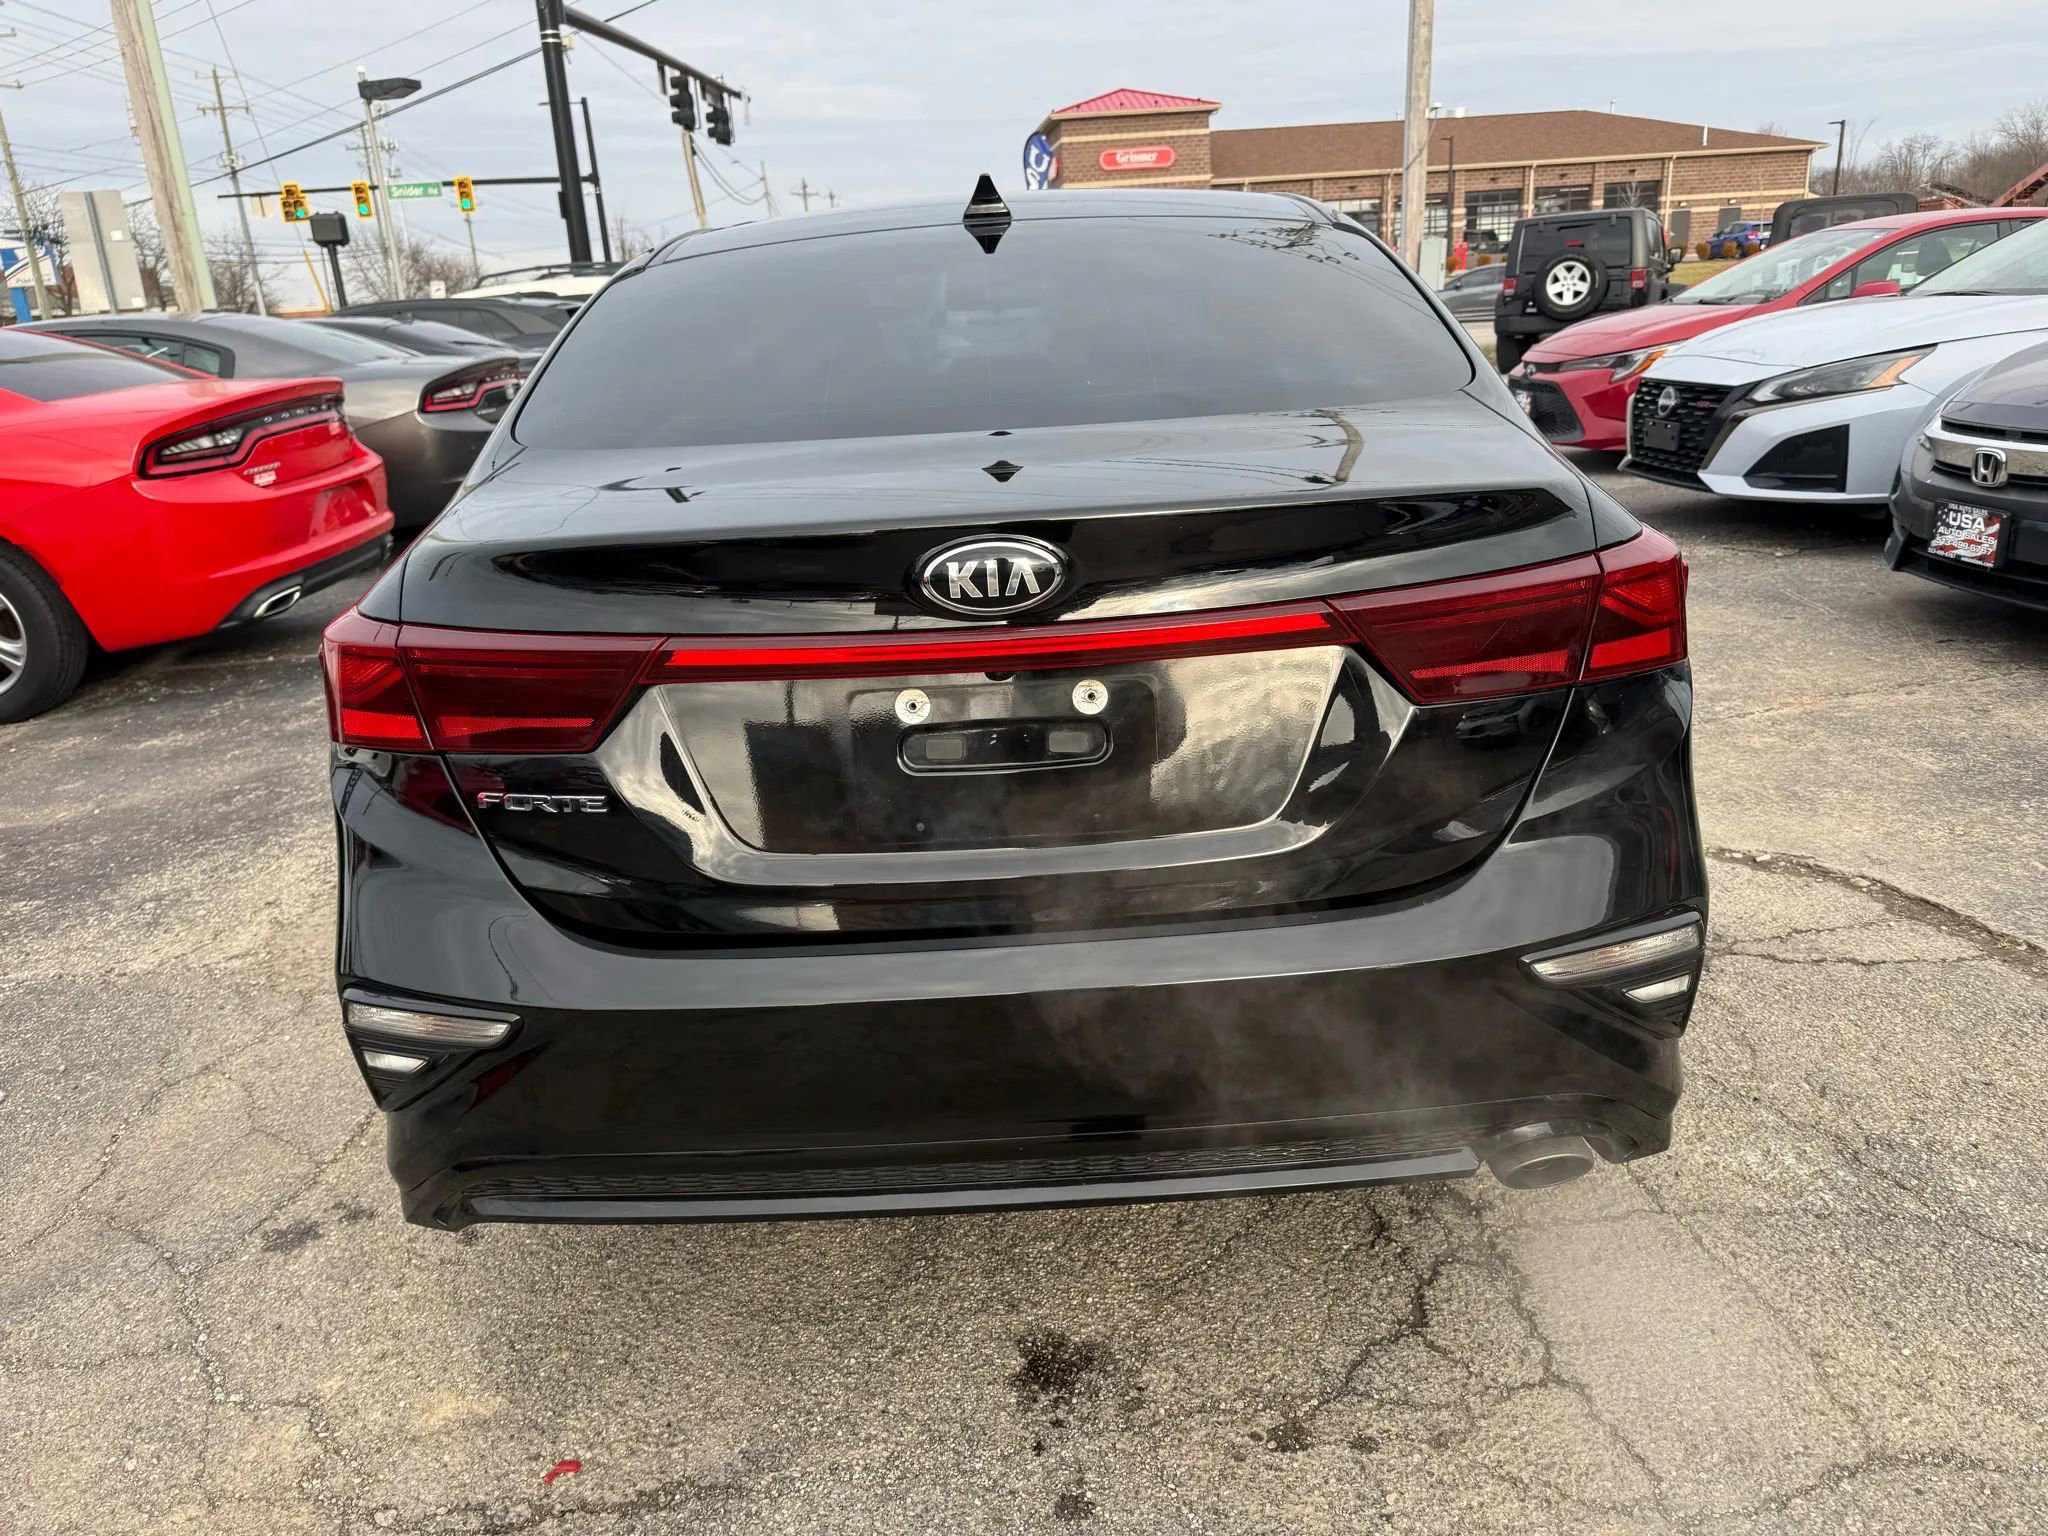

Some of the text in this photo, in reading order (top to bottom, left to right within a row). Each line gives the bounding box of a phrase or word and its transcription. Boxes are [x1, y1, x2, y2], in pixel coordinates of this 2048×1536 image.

[391, 185, 424, 198] Snider
[1949, 511, 1985, 532] USA
[1938, 526, 1995, 545] AUTO SALES
[1936, 536, 1993, 556] 513-499-6767
[946, 557, 1041, 598] KIA
[478, 792, 608, 813] FORTE
